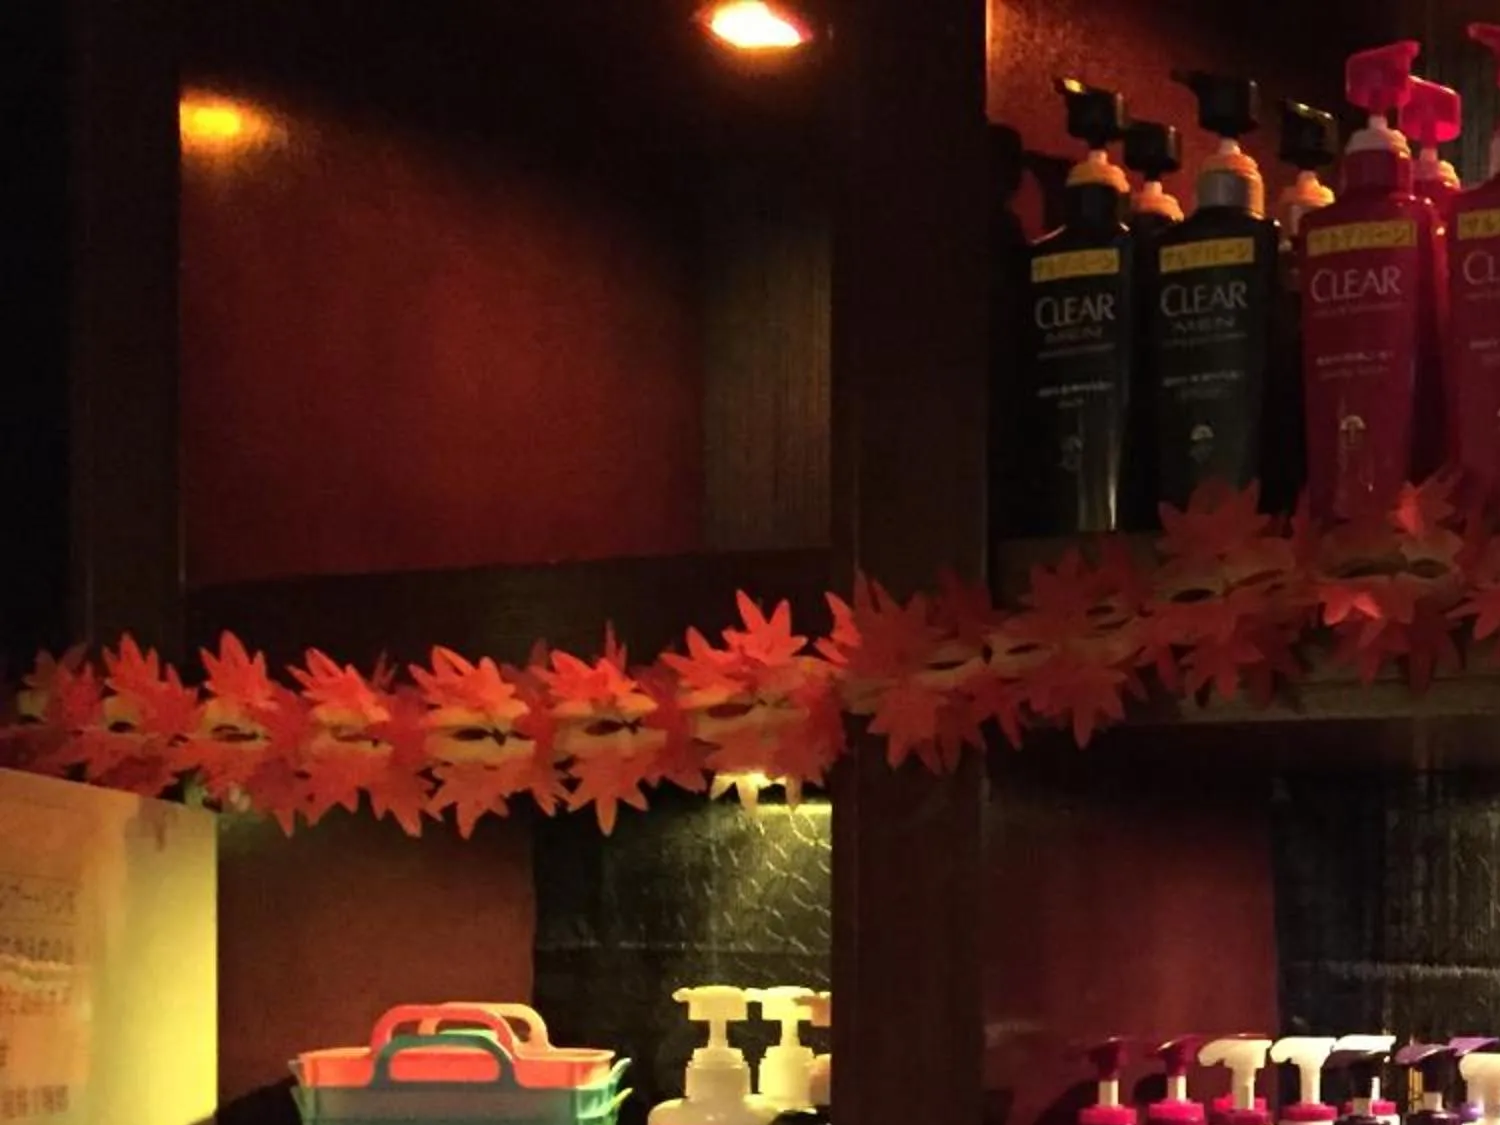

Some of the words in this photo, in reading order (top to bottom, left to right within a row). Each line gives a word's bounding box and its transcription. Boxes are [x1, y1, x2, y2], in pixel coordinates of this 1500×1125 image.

[1160, 280, 1249, 318] CLEAR
[1310, 264, 1402, 304] CLEAR
[1034, 292, 1117, 331] CLEAR
